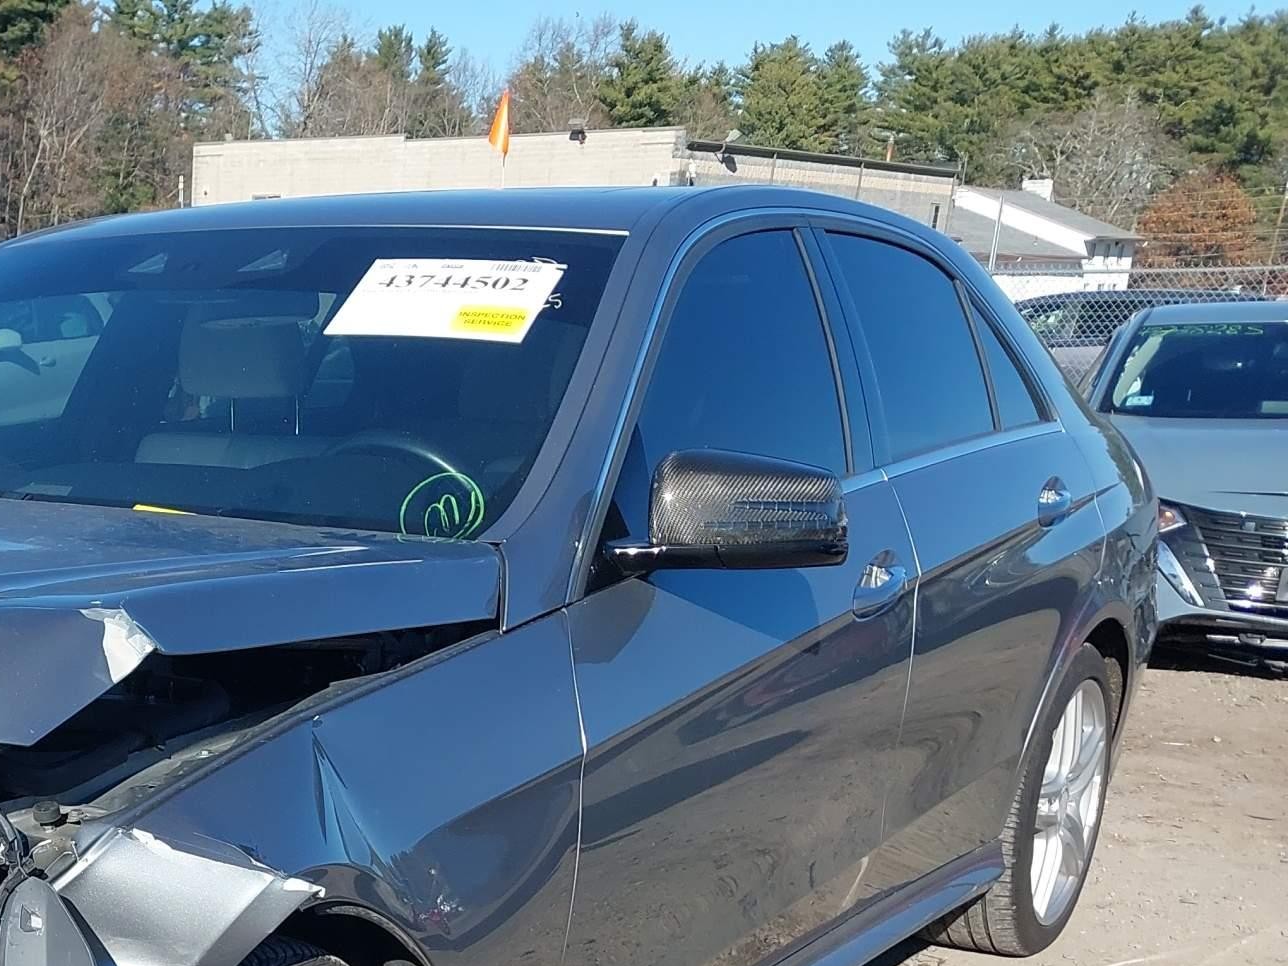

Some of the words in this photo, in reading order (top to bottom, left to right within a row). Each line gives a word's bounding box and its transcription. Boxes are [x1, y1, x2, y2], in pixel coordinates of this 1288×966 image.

[378, 274, 530, 291] 43744502
[458, 311, 526, 321] INSPECTION
[463, 318, 513, 327] SERVICE
